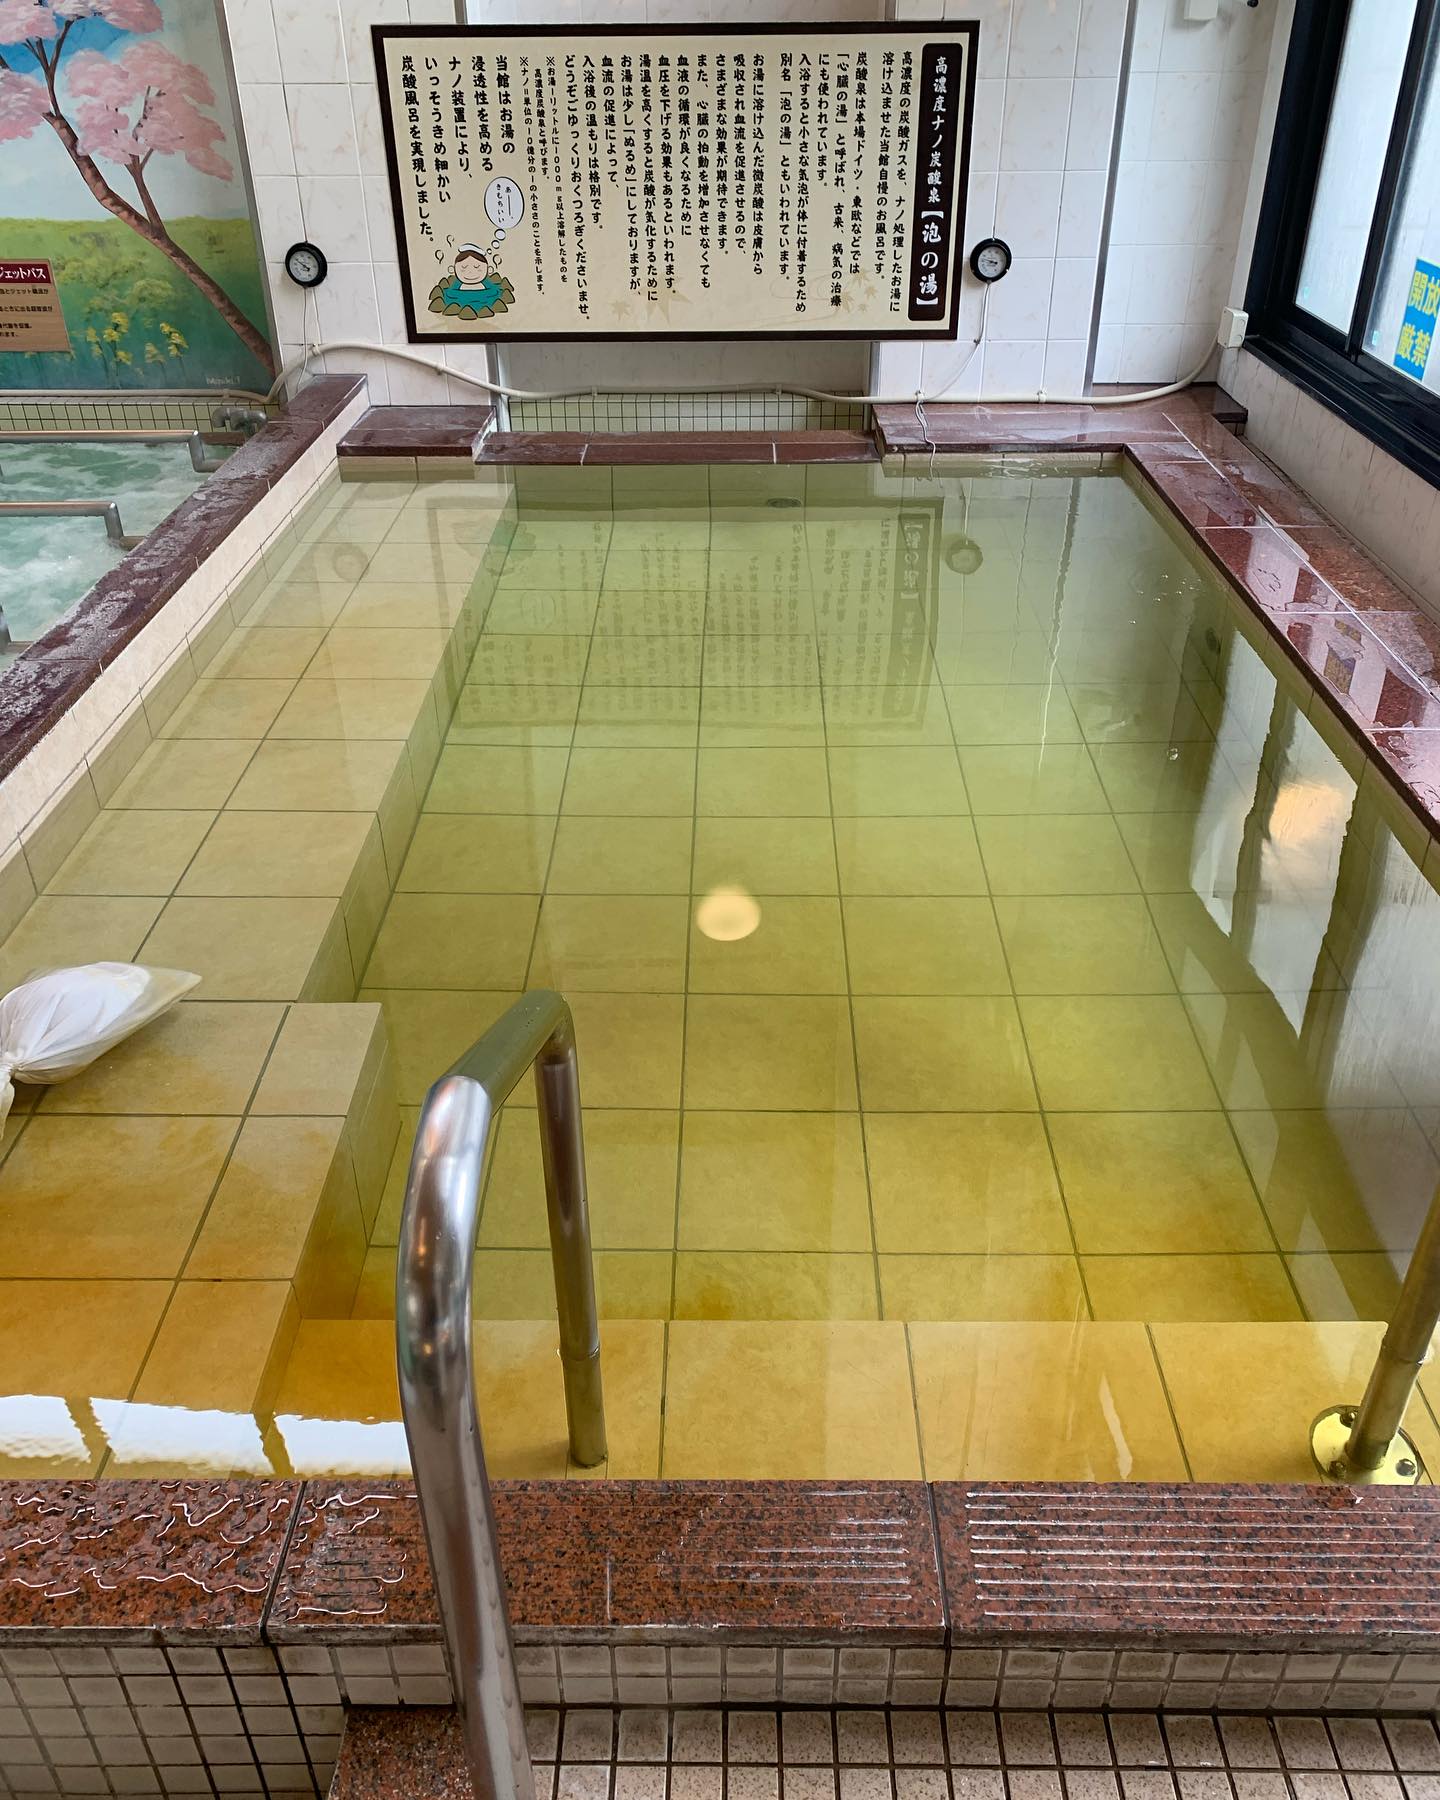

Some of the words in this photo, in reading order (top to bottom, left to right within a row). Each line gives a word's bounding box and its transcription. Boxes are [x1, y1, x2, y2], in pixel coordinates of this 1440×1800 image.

[402, 56, 434, 242] 炭酸風呂を実現しました。
[425, 57, 451, 202] いっそうきめ細かい
[448, 56, 473, 178] ナノ装置により、
[472, 56, 493, 172] 浸透性を高める
[496, 55, 516, 154] 当館はお湯の
[564, 55, 590, 320] どうぞごゆっくりおくつろぎくださいませ。
[582, 56, 602, 230] 入浴後の温もりは格別です。
[602, 56, 620, 189] 血流の促進によって、
[620, 55, 641, 296] お湯は少し「ぬるめ」にしておりますが、
[639, 54, 658, 301] 湯温を高くすると炭酸が気化するために
[658, 54, 676, 294] 血圧を下げる効果もあるといわれます。
[677, 55, 692, 236] 血液の循環が良くなるために
[696, 55, 711, 289] また、心臓の拍動を増加させなくても
[715, 55, 729, 255] さまざまな効果が期待できます。
[734, 55, 747, 255] 吸収され血流を促進させるので、
[752, 55, 764, 274] お湯に溶け込んだ微炭酸は皮膚から
[779, 53, 792, 281] 別名「泡の湯」ともいわれています。
[796, 53, 811, 312] 入浴すると小さな気泡が体に付着するため
[816, 53, 830, 187] にも使われています。
[849, 52, 868, 274] 炭酸泉は本場ドイツ・東欧などでは
[874, 52, 895, 279] 溶け込ませた当館自慢のお風呂です。
[889, 51, 913, 312] 高濃度の炭酸ガスを、ナノ処理したお湯に
[916, 56, 948, 306] 高濃度ナノ炭酸泉【泡の湯】
[1398, 323, 1430, 368] 厳禁
[1408, 271, 1440, 318] 開放
